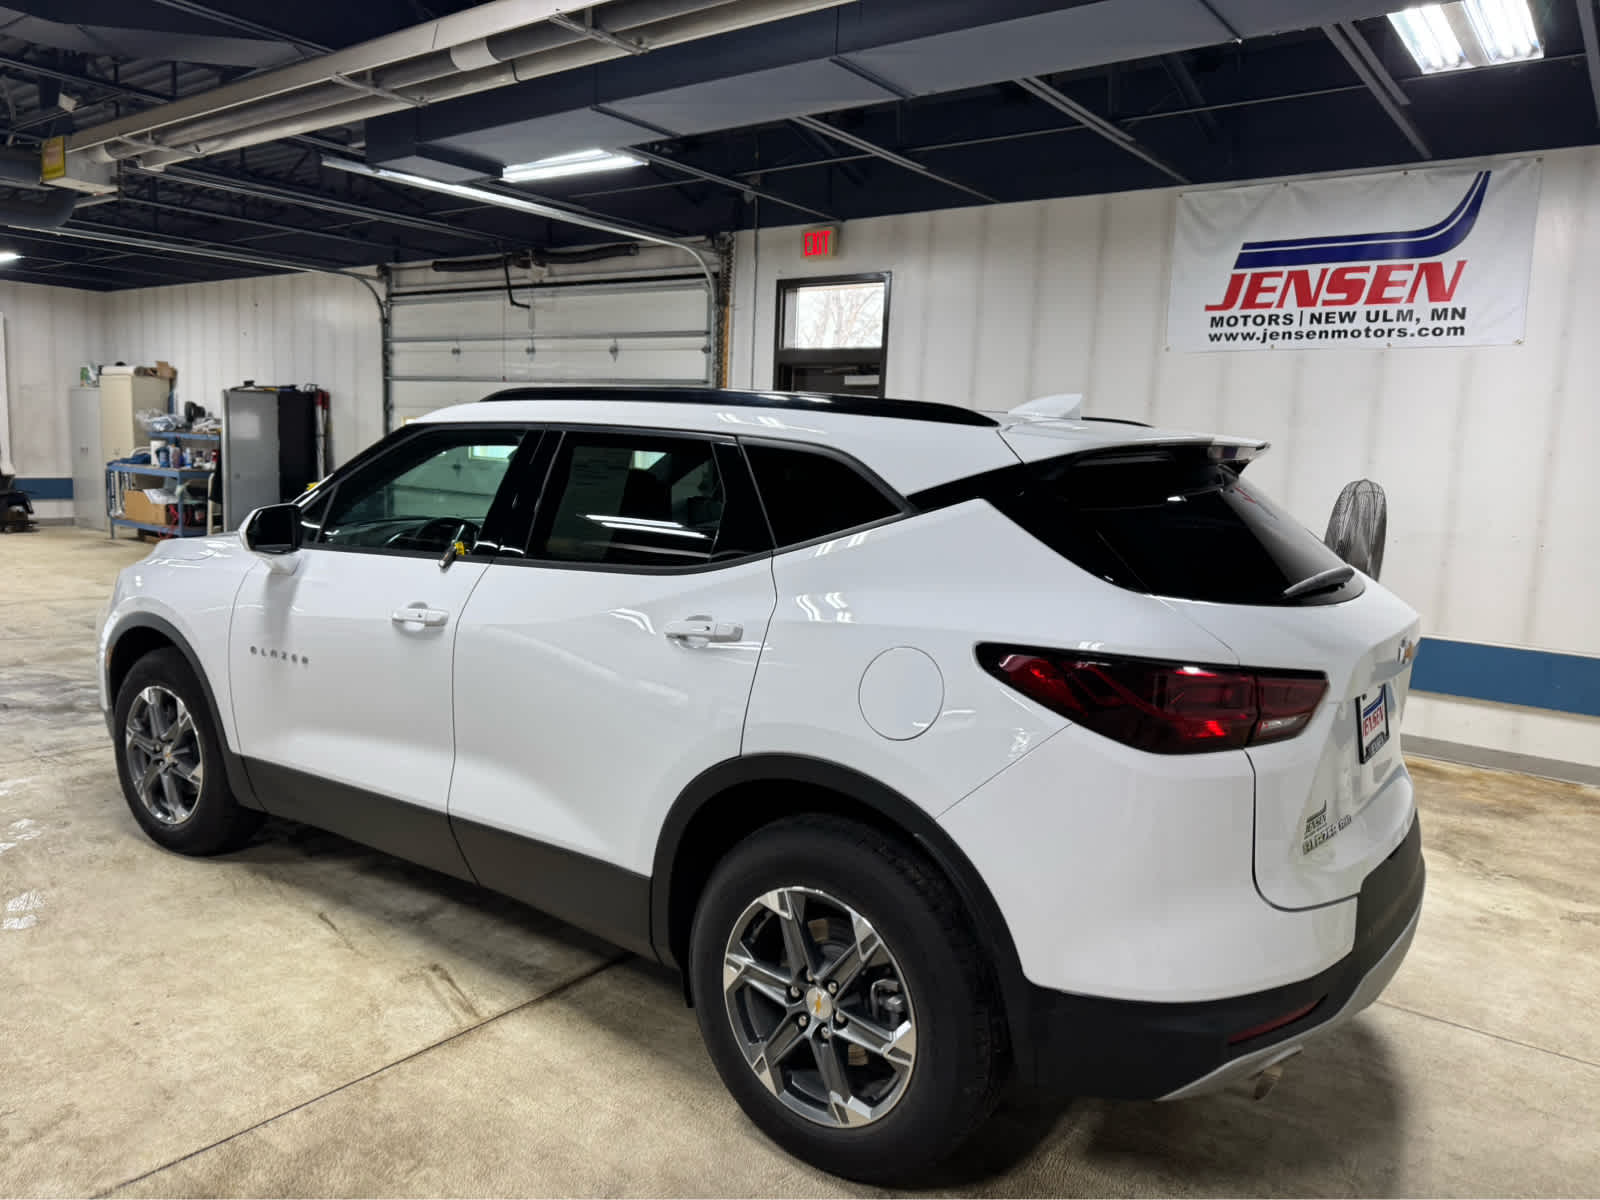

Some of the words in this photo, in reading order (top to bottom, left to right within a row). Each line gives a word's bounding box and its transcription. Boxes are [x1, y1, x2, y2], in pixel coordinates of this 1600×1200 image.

[804, 230, 832, 257] EXIT
[1204, 260, 1468, 312] JENSEN
[1210, 312, 1294, 328] MOTORS
[1309, 310, 1357, 325] NEW
[1365, 309, 1421, 325] ULM,
[1430, 307, 1467, 322] MN
[1208, 325, 1466, 344] www.jensenmotors.com
